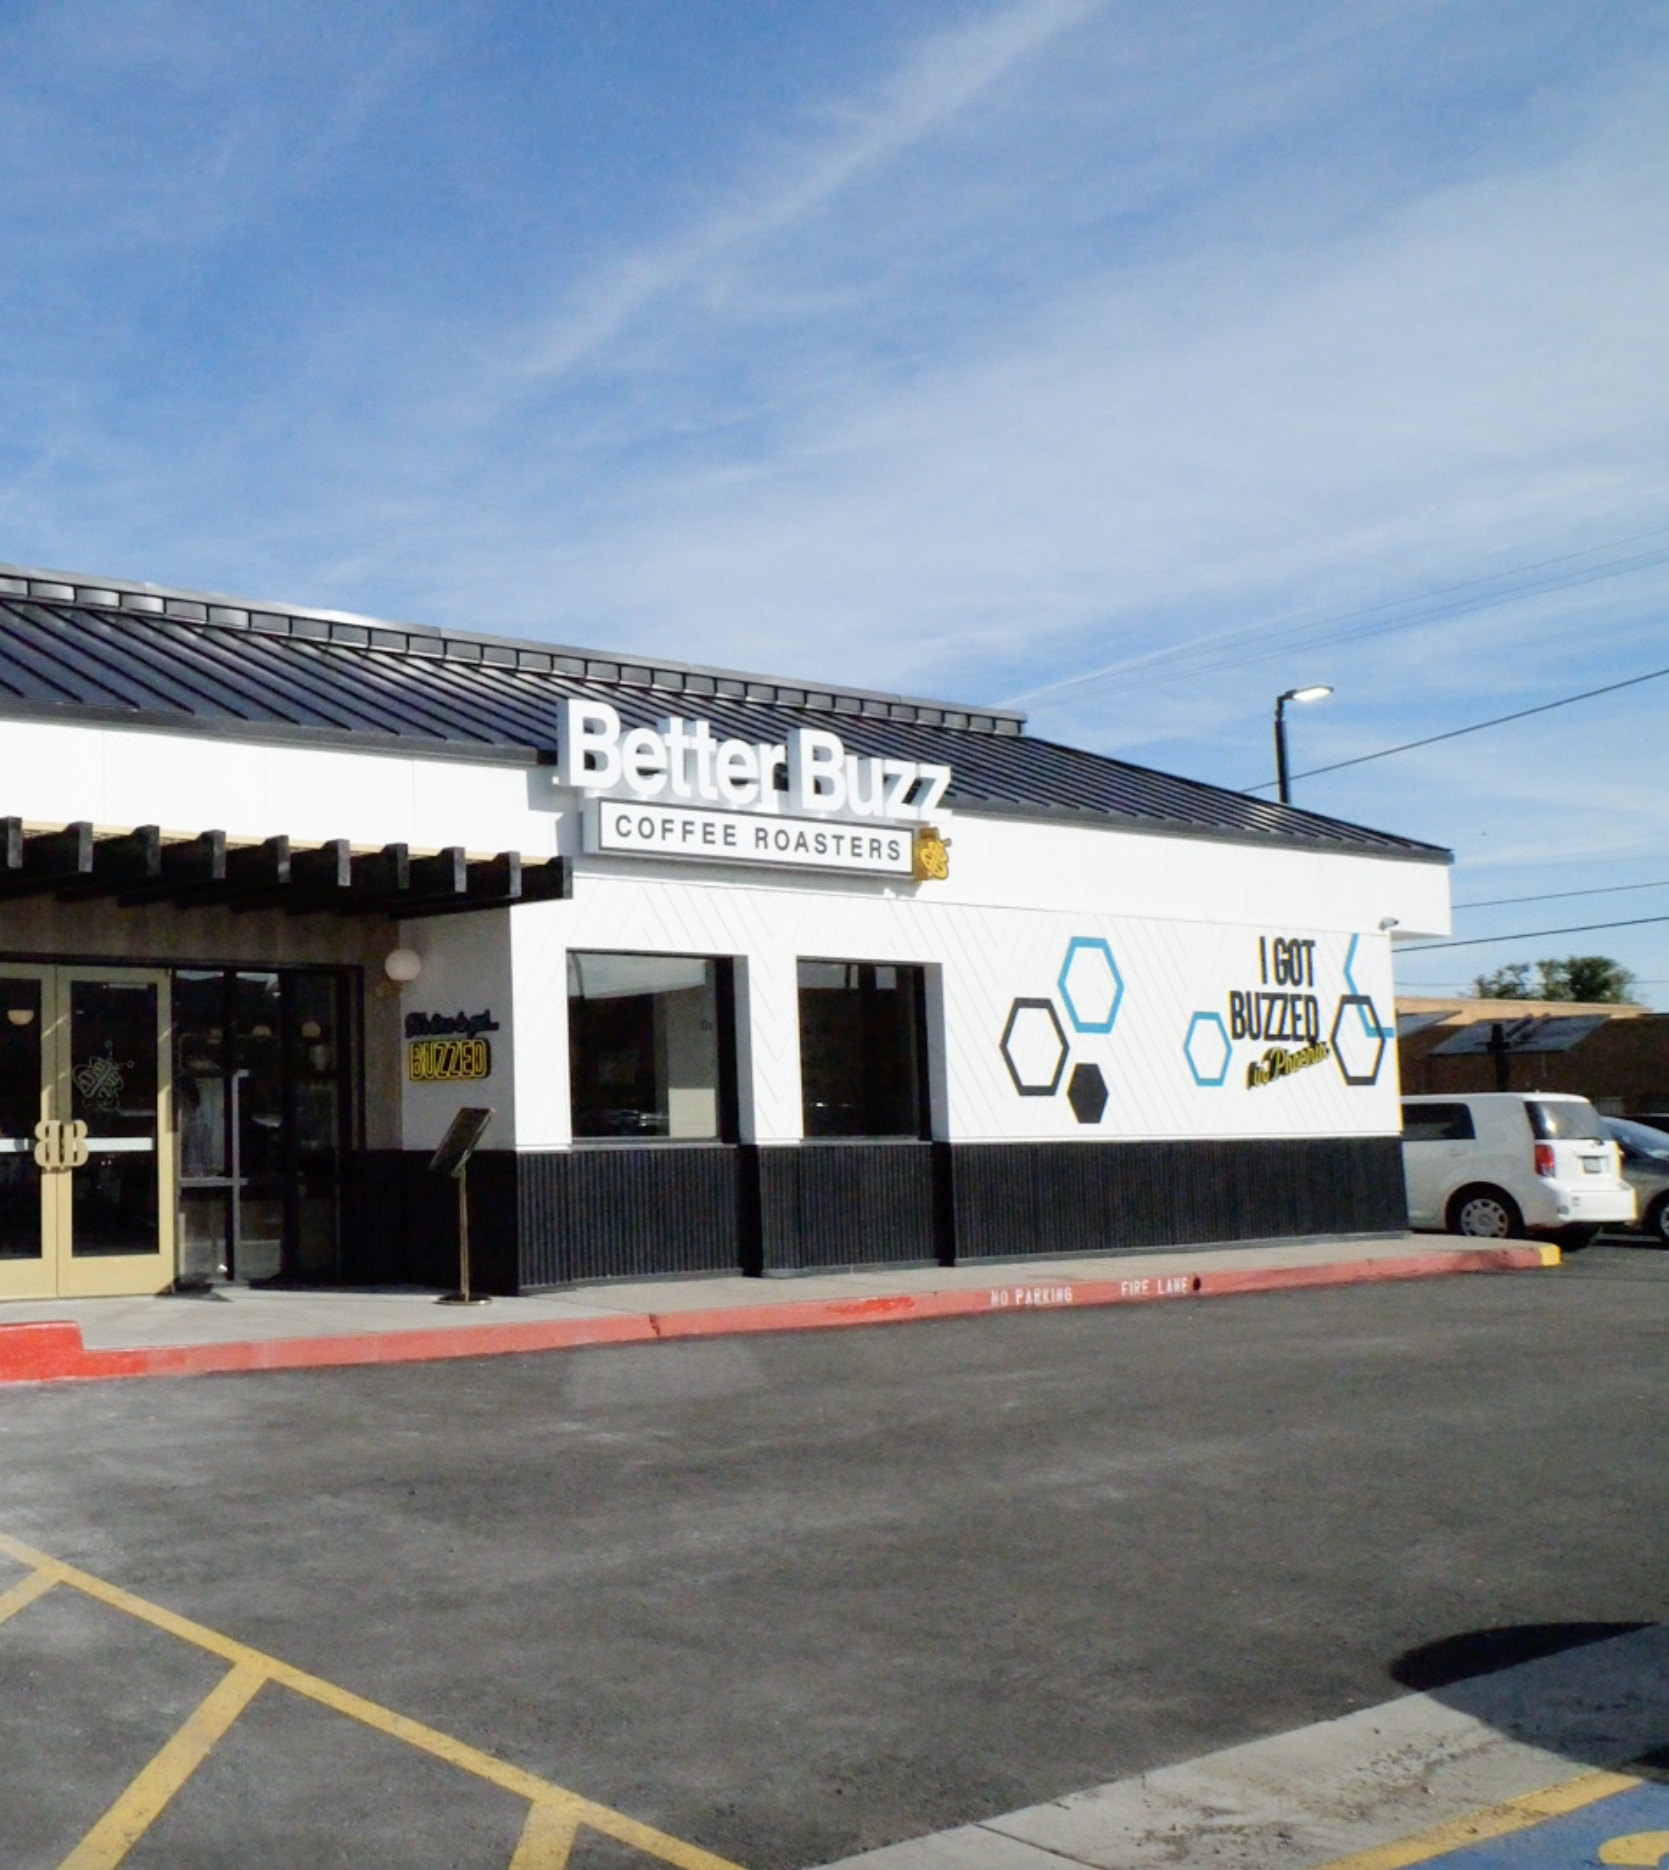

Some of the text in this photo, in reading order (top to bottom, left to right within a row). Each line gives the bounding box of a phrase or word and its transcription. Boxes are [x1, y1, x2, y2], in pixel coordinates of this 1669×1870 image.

[559, 698, 952, 822] Better Buzz
[615, 814, 901, 861] COFFEE ROASTERS
[1259, 936, 1316, 987] I GOT
[1229, 990, 1319, 1042] BUZZED
[409, 1040, 490, 1079] BUZZED
[990, 1287, 1073, 1306] NO PARKING
[1121, 1277, 1189, 1296] FIRE LANE
